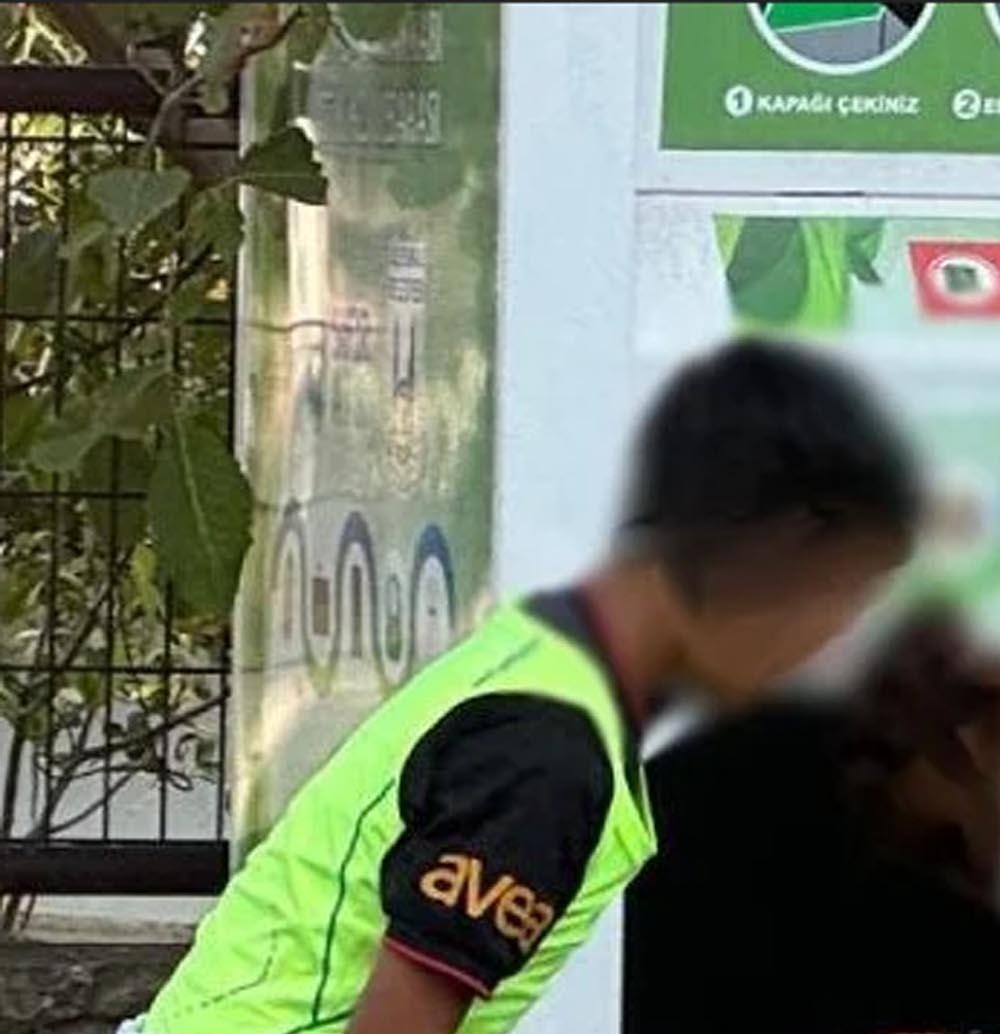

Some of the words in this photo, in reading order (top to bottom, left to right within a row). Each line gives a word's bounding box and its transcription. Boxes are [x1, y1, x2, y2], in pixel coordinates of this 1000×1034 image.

[757, 92, 833, 113] KAPAĞI
[838, 93, 920, 117] ÇEKİNİZ
[419, 854, 555, 953] avea
